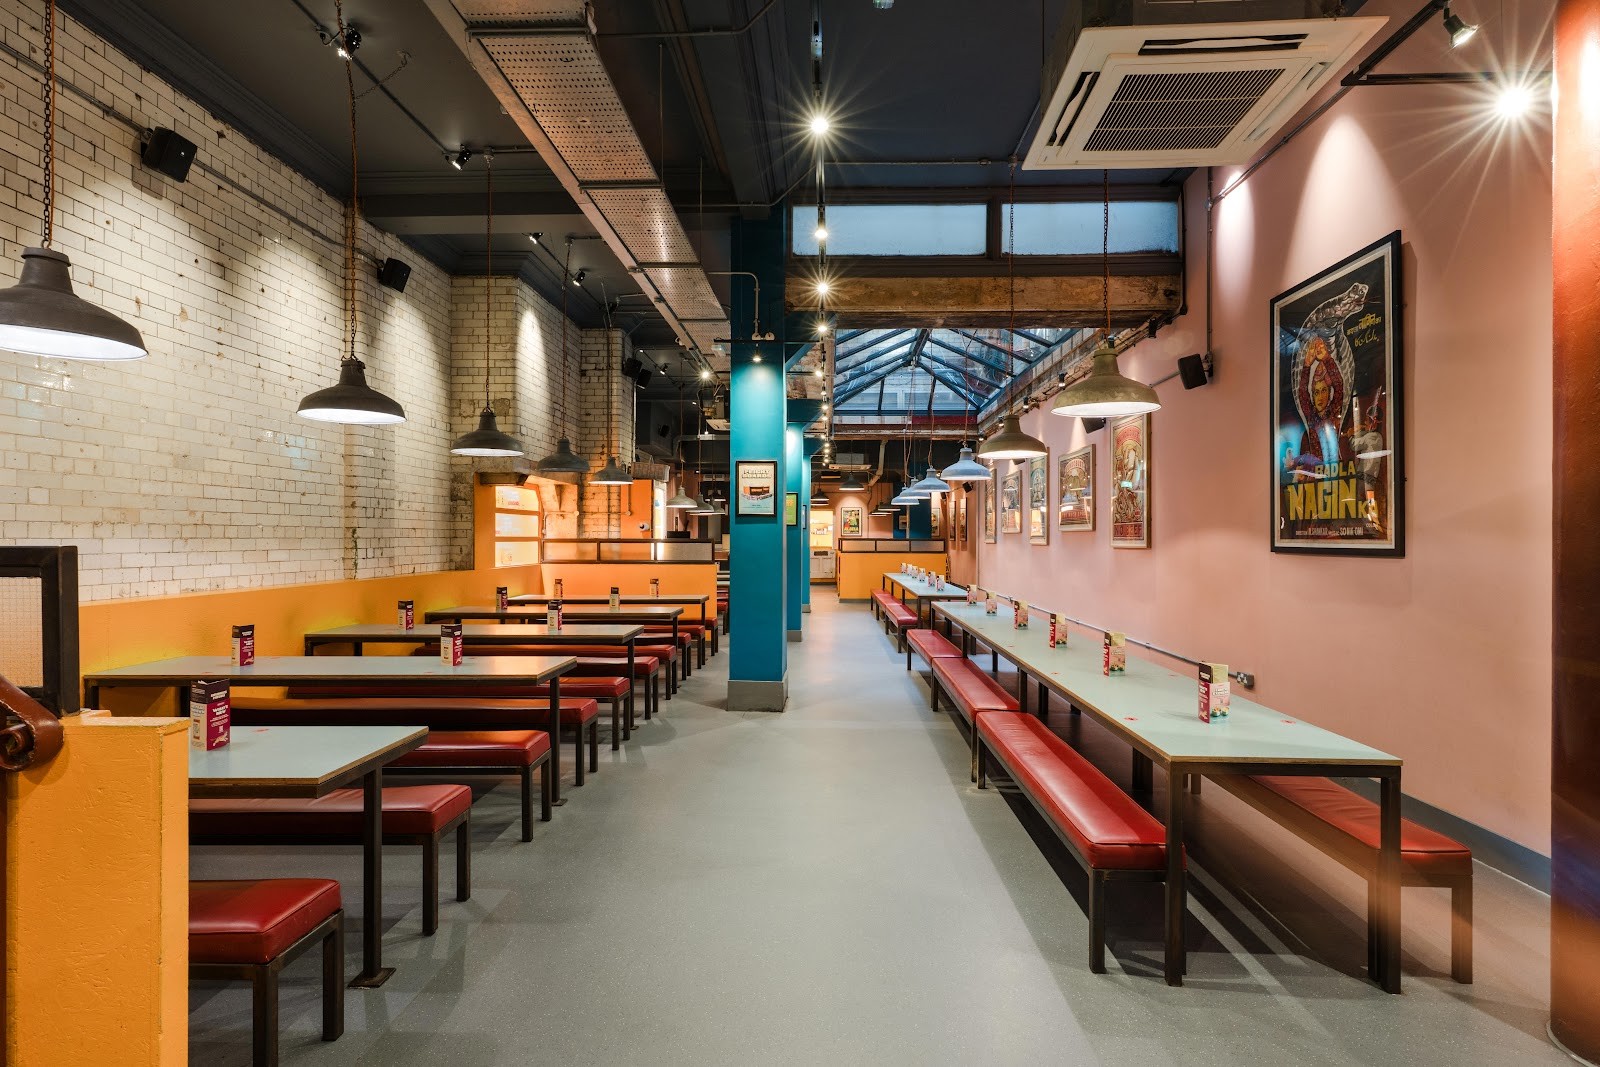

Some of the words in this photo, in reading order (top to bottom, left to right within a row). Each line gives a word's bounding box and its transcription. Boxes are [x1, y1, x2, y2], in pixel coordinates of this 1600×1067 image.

[1315, 461, 1356, 479] BADLA
[1287, 478, 1357, 520] NAGIN
[1114, 524, 1123, 536] NO
[1124, 523, 1143, 536] BEEF
